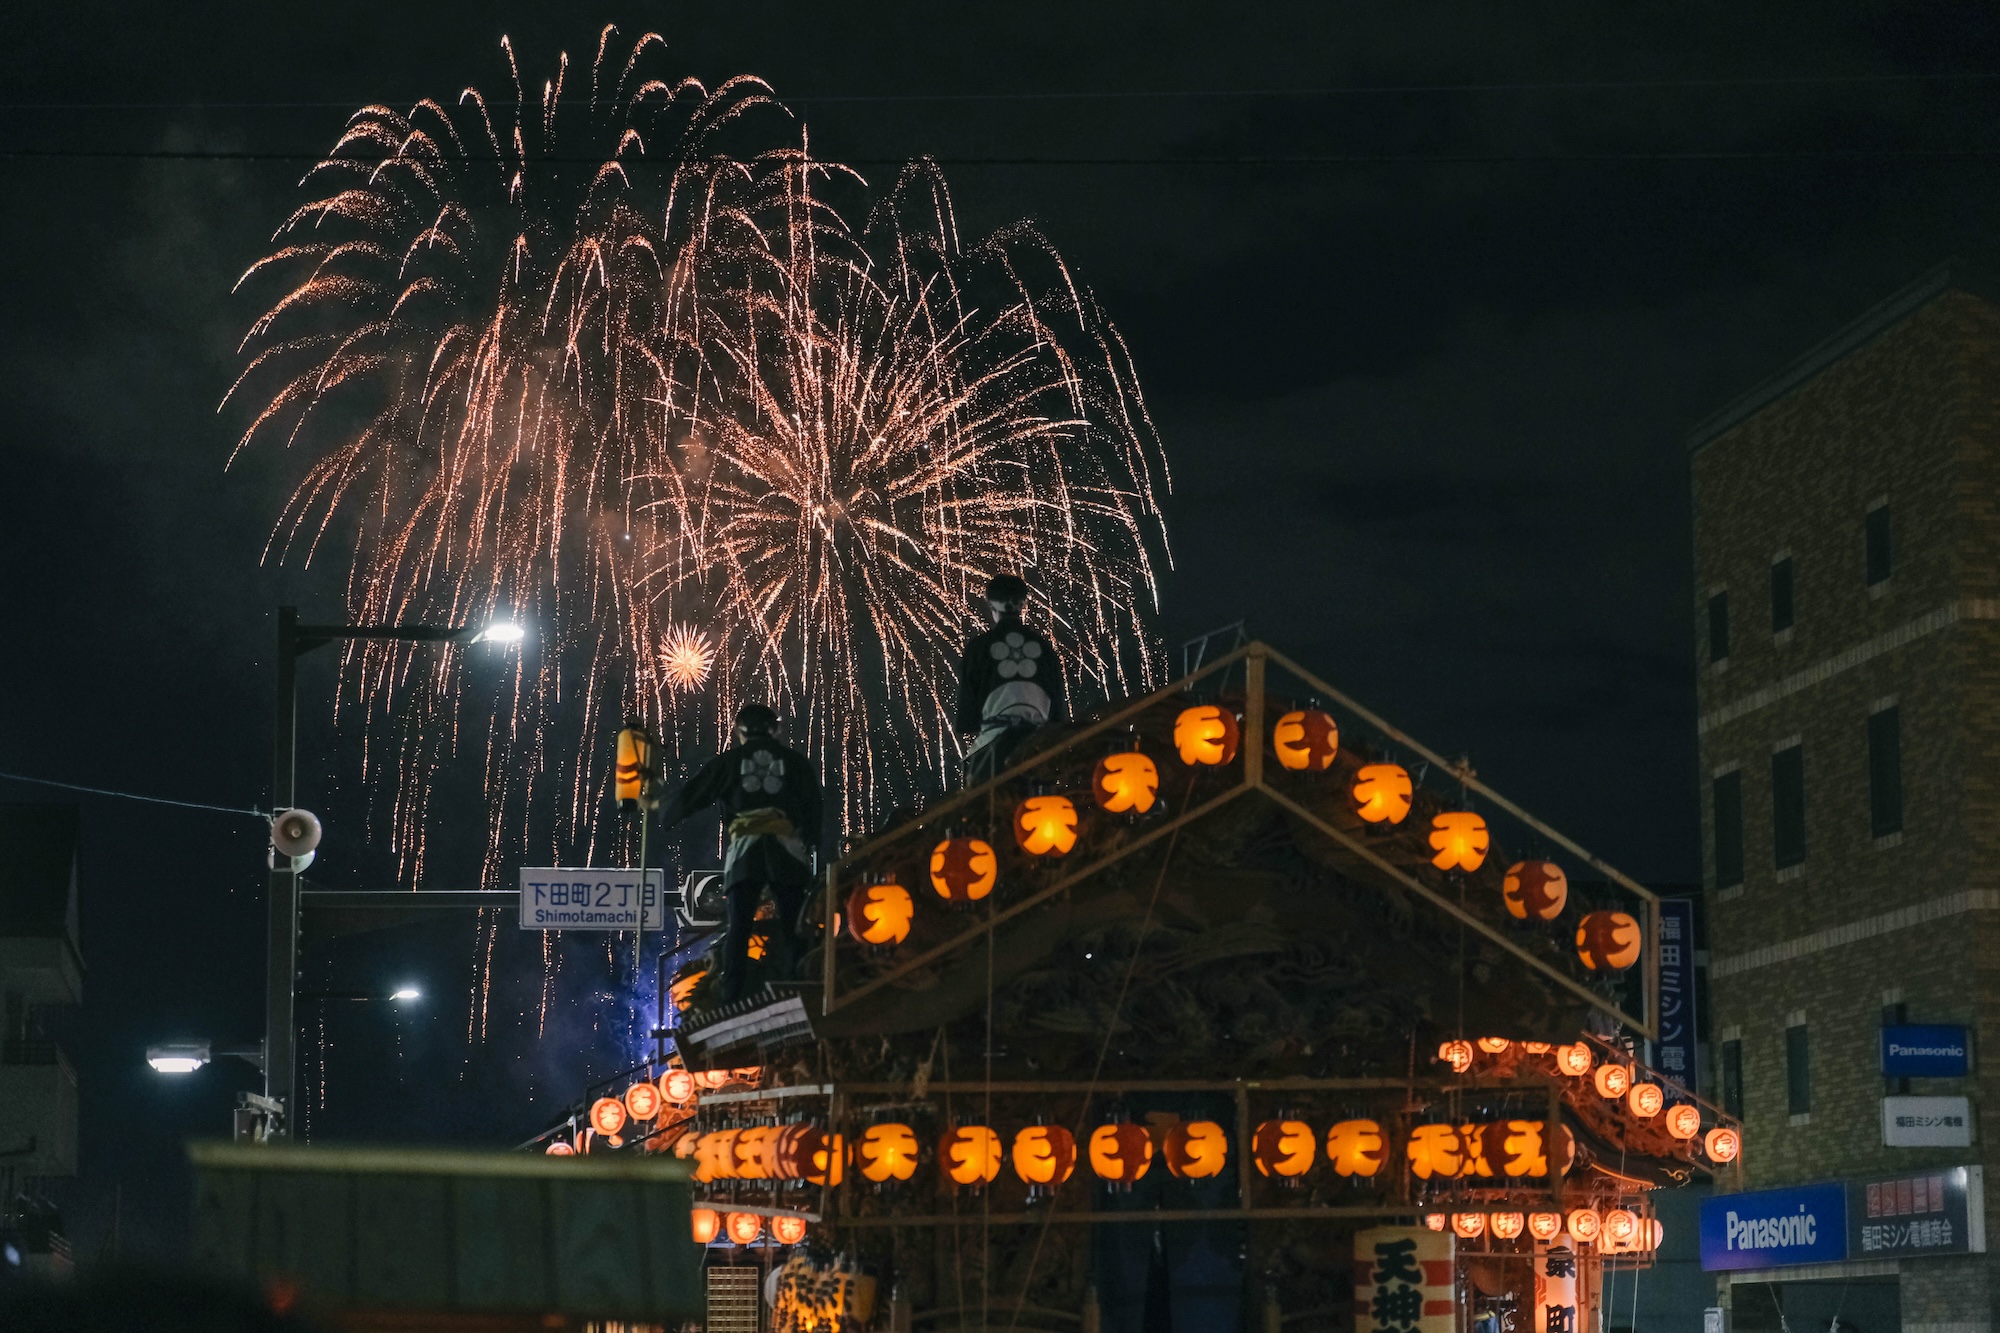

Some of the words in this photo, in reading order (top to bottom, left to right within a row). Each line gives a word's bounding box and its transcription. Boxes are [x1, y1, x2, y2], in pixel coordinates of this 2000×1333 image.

[528, 882, 656, 907] 下田町2丁目
[535, 910, 637, 923] Shimotamachi
[1658, 916, 1687, 1100] 福田ミシン電機
[1889, 1044, 1964, 1058] Panasonic
[1895, 1115, 1963, 1128] 福田ミシン電機
[1726, 1204, 1817, 1250] Panasonic
[1861, 1218, 1953, 1252] 福田ミシン電機商会
[1372, 1237, 1423, 1333] 天神
